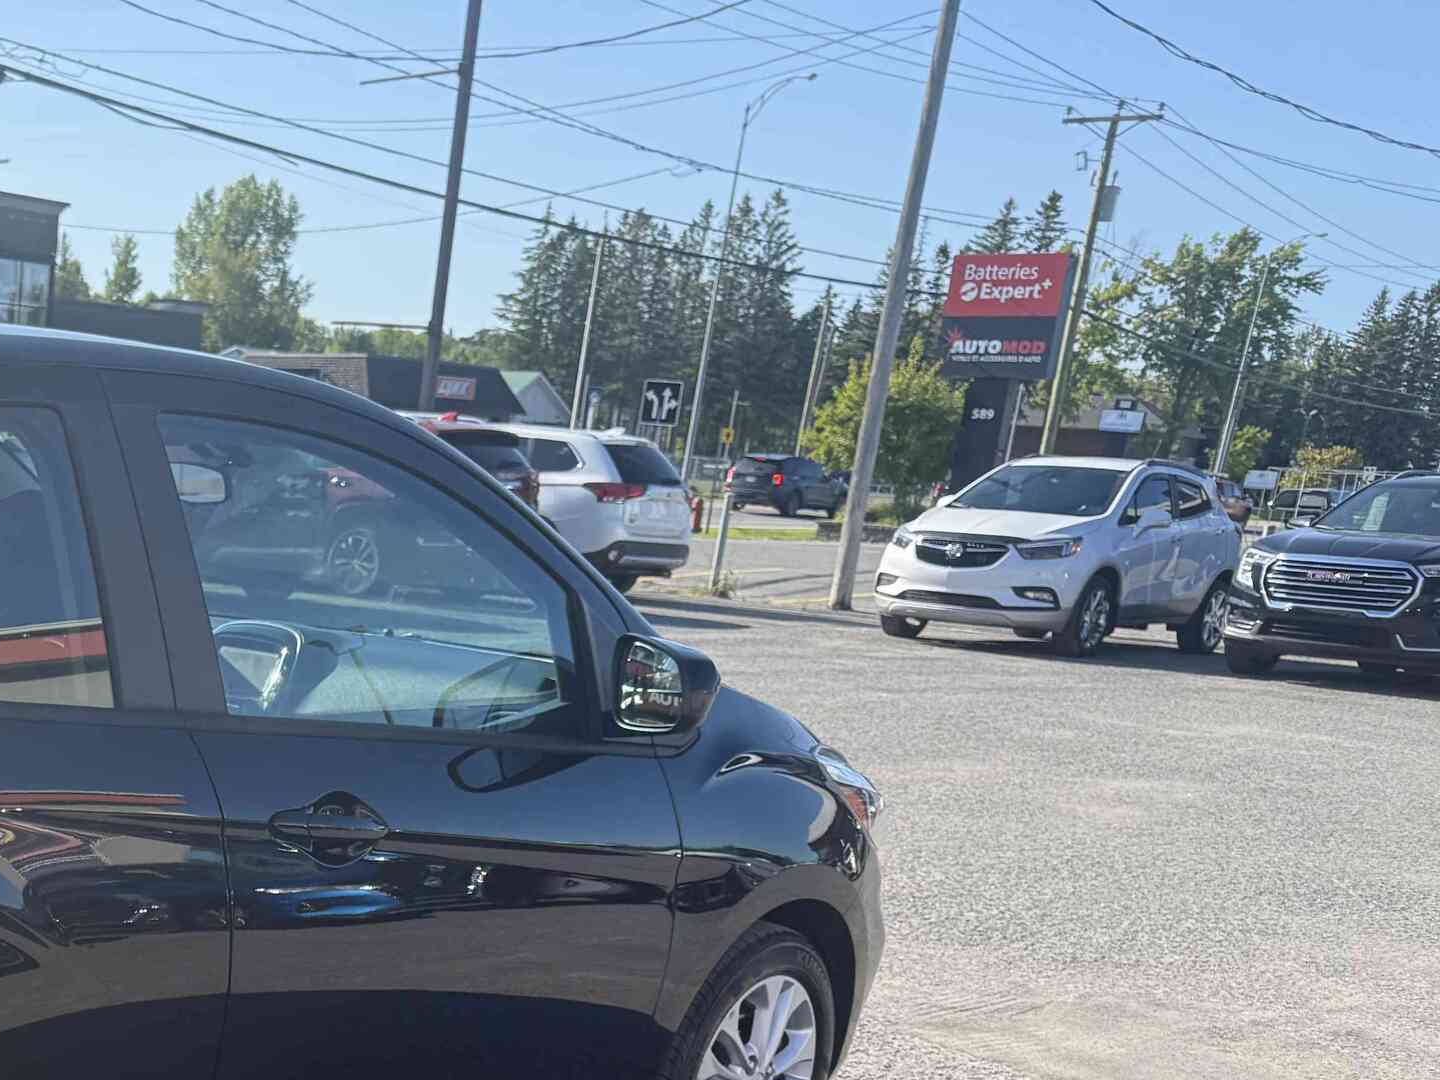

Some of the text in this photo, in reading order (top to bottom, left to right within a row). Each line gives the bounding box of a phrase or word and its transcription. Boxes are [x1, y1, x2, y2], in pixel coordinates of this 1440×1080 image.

[964, 263, 1040, 281] Batteries
[949, 340, 1047, 354] AUTOMOD
[970, 408, 995, 421] 589
